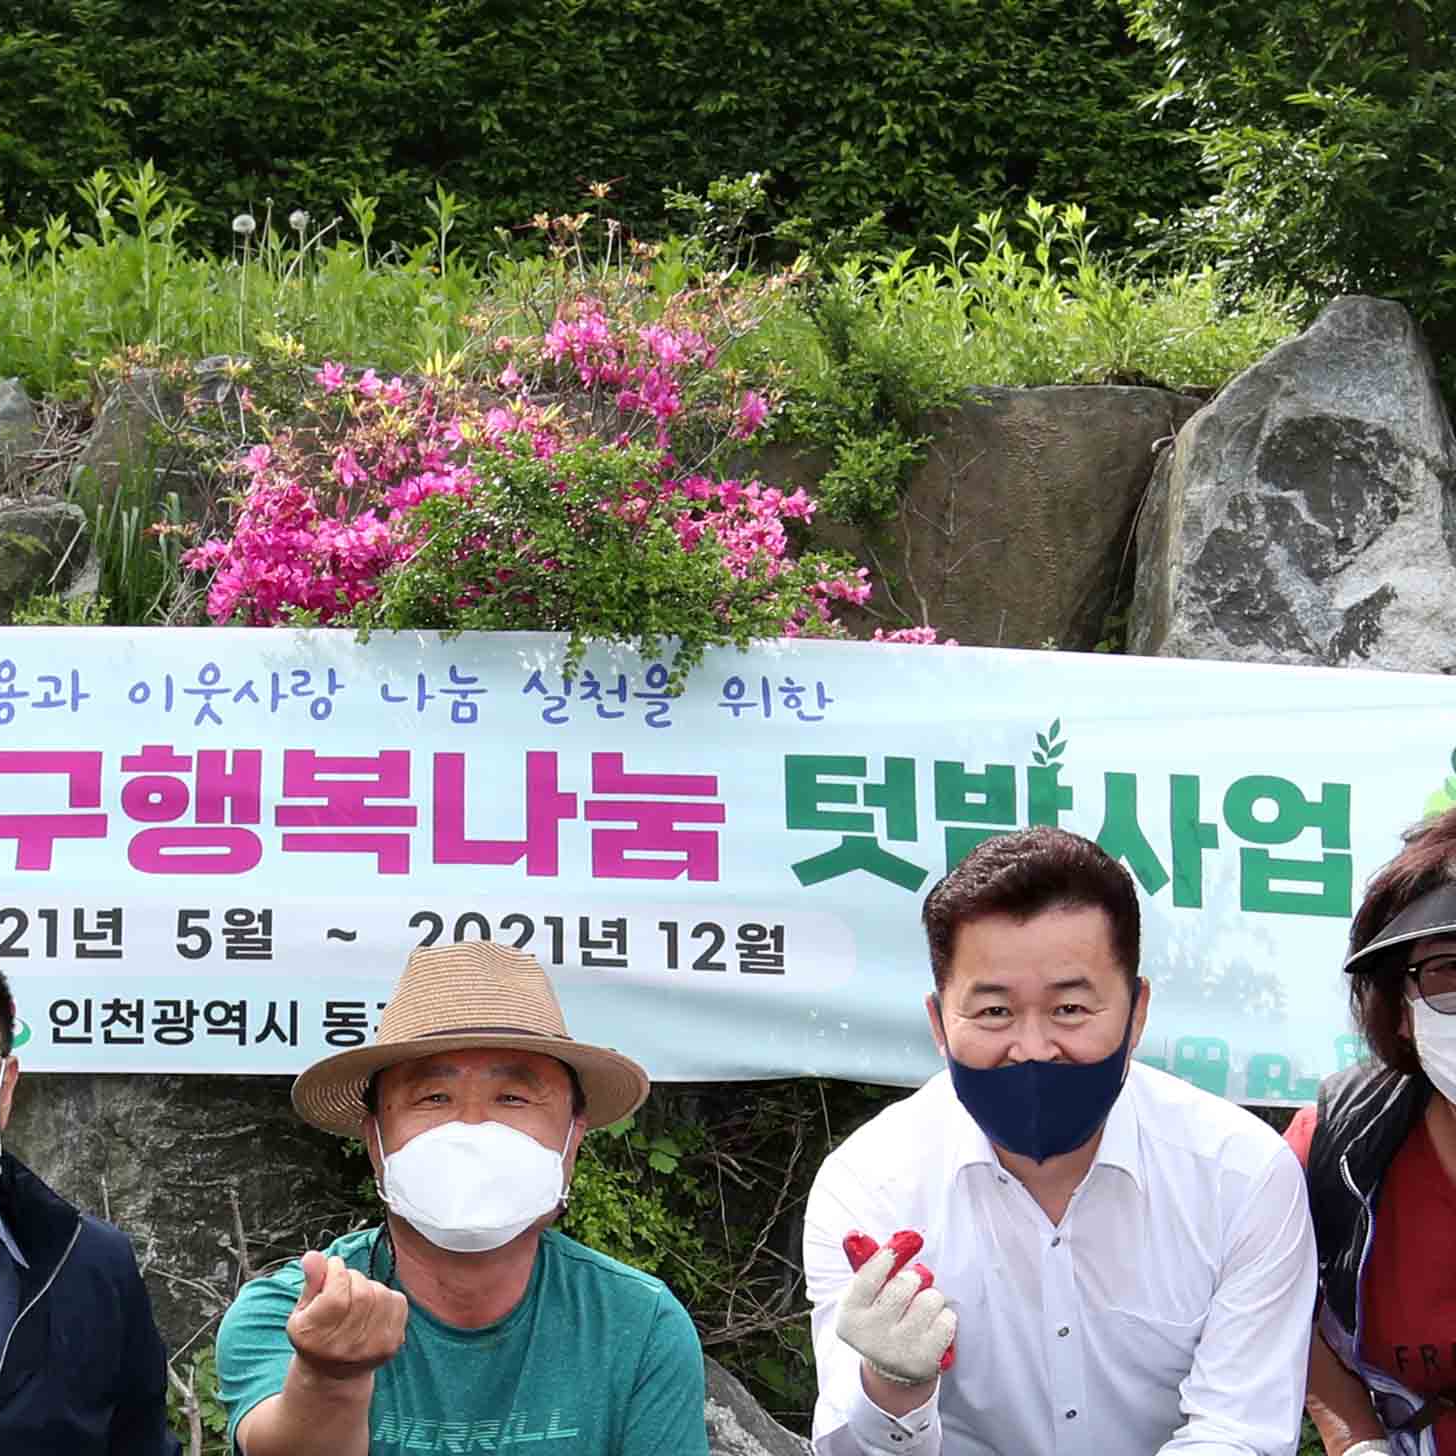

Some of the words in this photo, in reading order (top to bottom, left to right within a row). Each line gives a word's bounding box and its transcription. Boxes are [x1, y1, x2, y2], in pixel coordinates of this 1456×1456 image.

[127, 660, 346, 725] 이웃사랑
[379, 664, 490, 725] 나눔
[520, 662, 682, 730] 실천을
[718, 674, 835, 722] 위한
[784, 752, 1353, 918] 텃밭사업
[174, 907, 275, 961] 5월
[656, 920, 786, 976] 12월
[48, 997, 300, 1048] 인천광역시
[323, 1000, 387, 1047] 동
